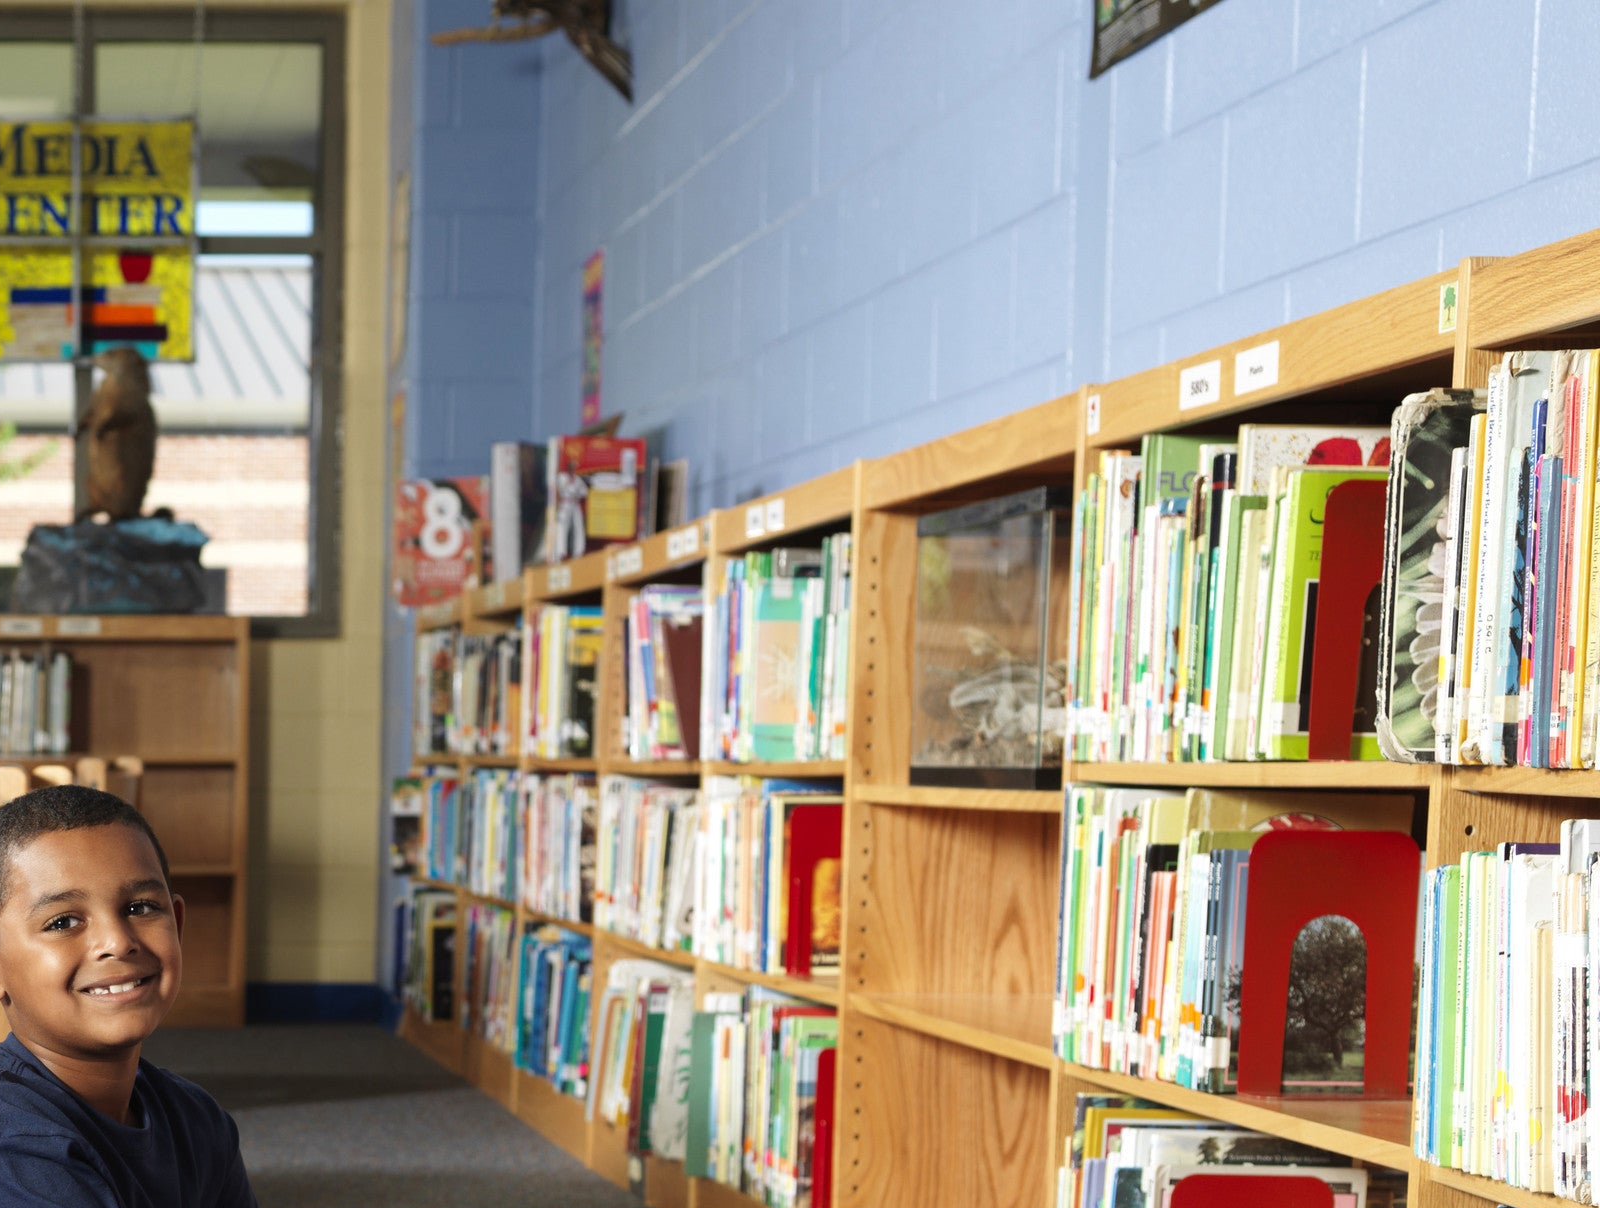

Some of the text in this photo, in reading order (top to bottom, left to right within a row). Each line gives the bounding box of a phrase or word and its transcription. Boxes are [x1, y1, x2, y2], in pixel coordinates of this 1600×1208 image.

[1489, 374, 1498, 416] Charlie
[1487, 418, 1495, 462] Brown's
[1485, 464, 1493, 496] Super
[1483, 498, 1491, 526] Book
[1526, 496, 1534, 538] ANIMALS
[1479, 544, 1488, 600] Questions
[1591, 566, 1599, 582] the
[1592, 548, 1600, 562] do
[1502, 554, 1512, 604] ANIMALS
[1474, 626, 1483, 672] Answers
